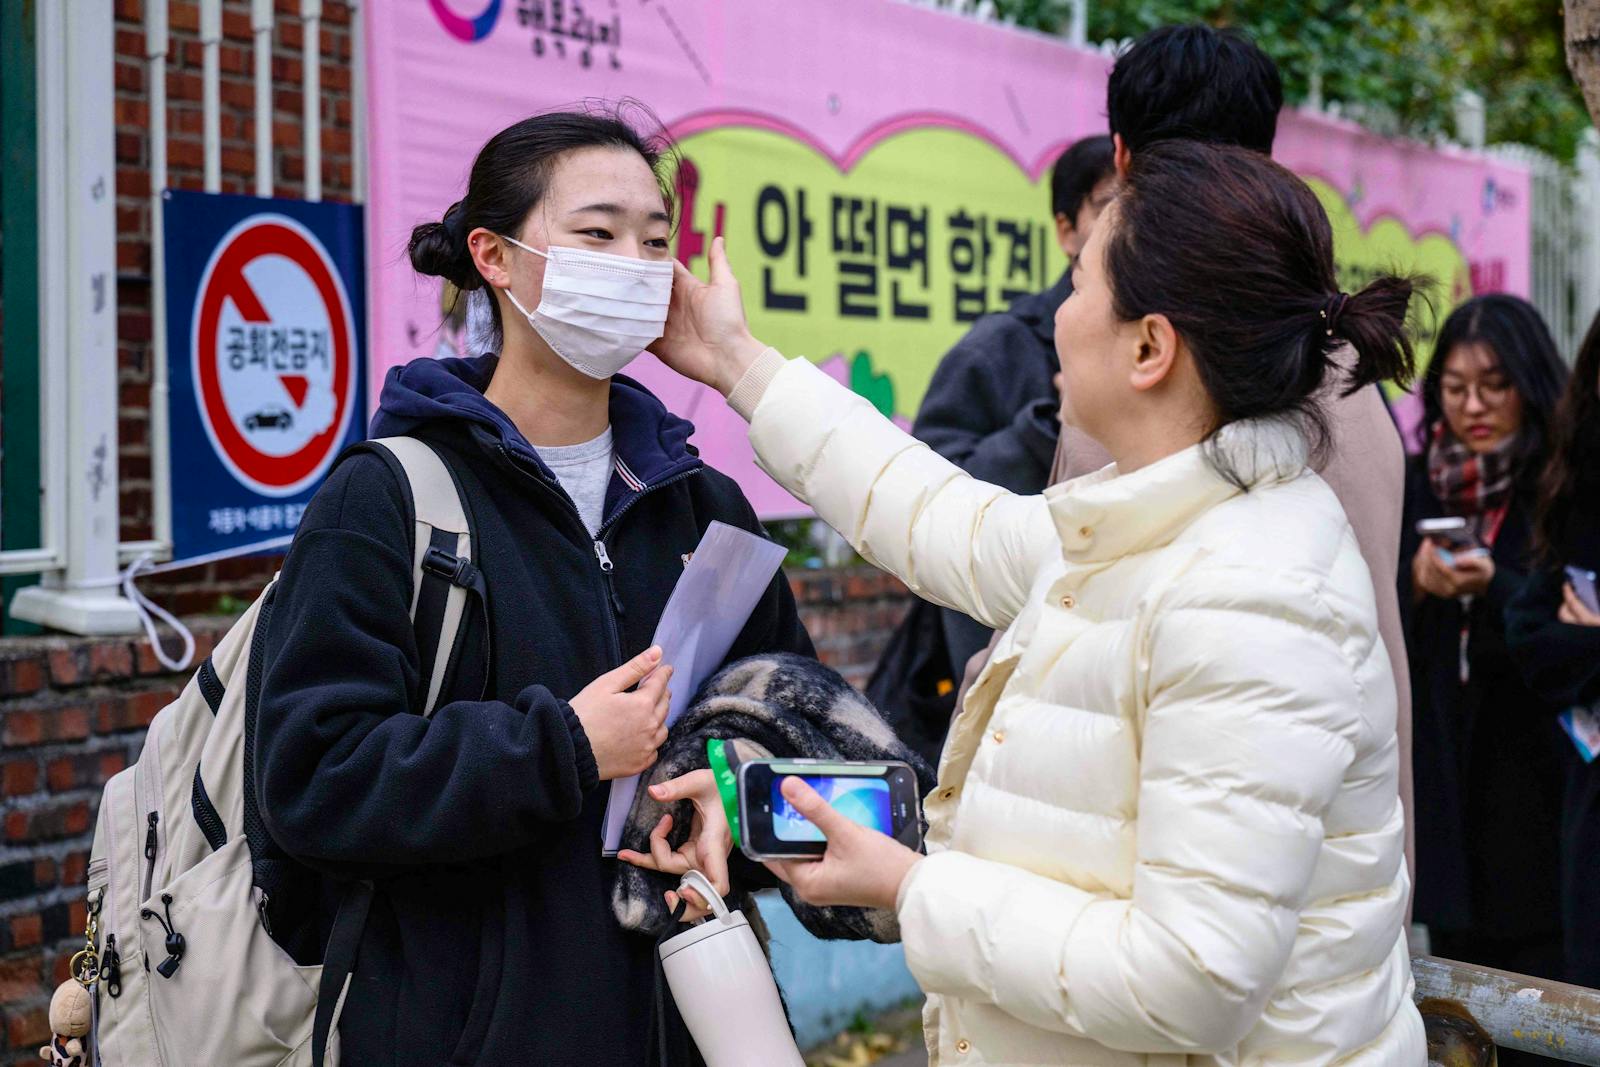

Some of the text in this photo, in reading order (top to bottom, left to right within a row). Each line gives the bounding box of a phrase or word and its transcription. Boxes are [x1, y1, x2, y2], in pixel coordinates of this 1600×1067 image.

[755, 184, 813, 313] 안
[831, 193, 932, 321] 떨면
[226, 325, 329, 371] 공회전금지
